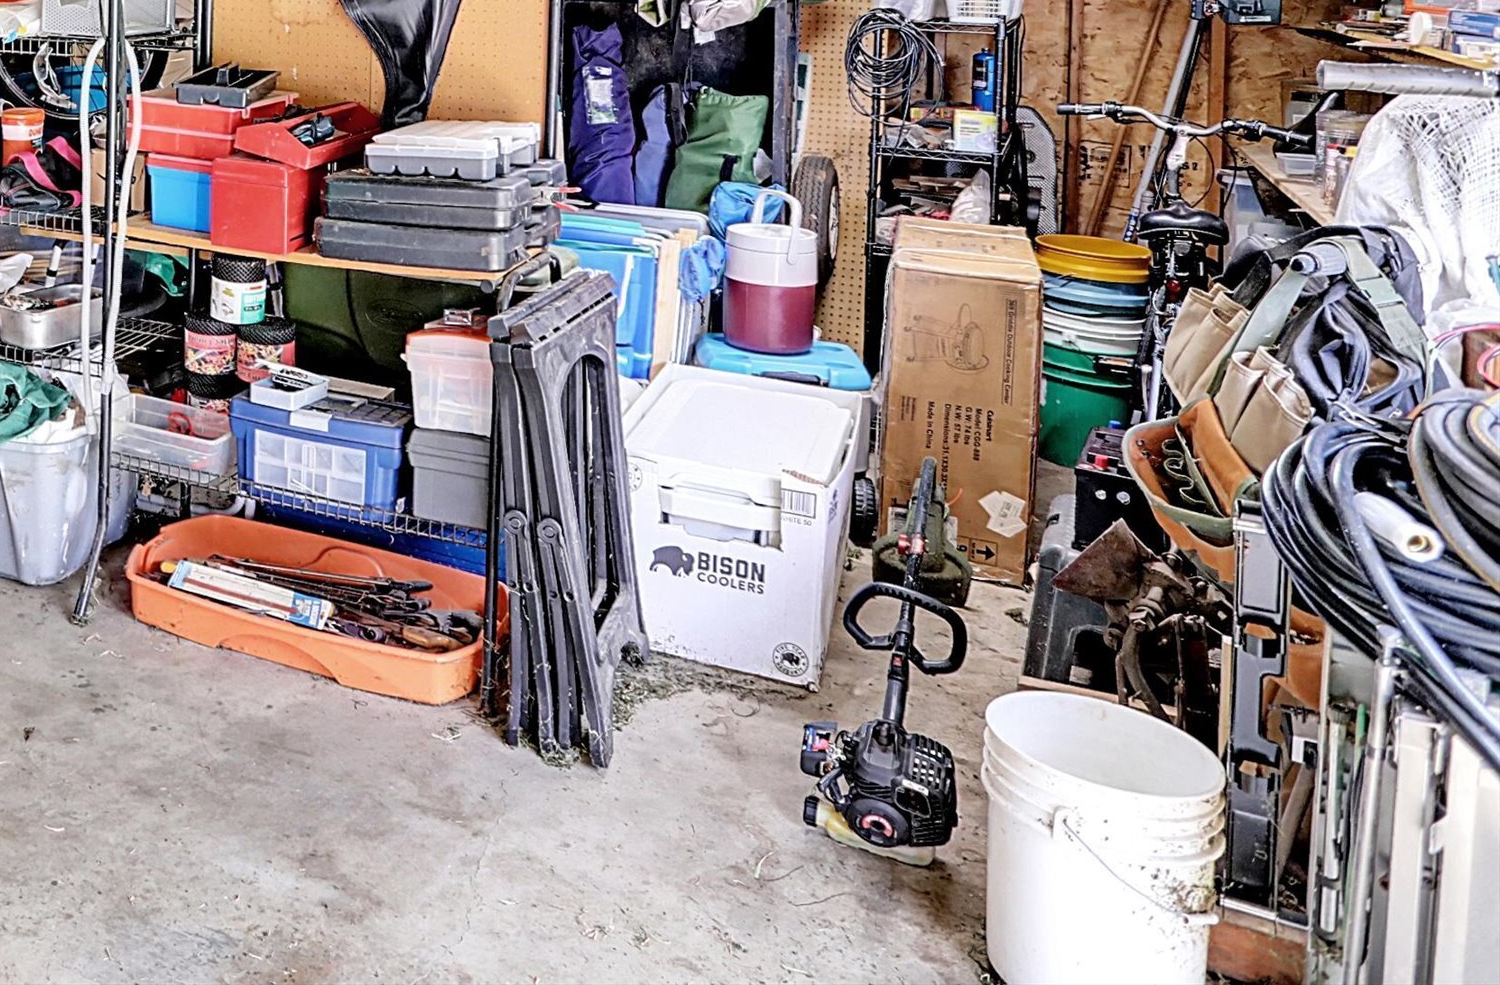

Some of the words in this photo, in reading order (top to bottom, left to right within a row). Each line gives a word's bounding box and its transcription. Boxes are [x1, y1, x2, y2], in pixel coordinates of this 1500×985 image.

[1006, 333, 1014, 359] Outdoor
[1003, 359, 1013, 383] Cooking
[1003, 384, 1012, 404] Center
[927, 401, 936, 420] Made
[974, 408, 983, 429] Model
[925, 428, 935, 450] China
[697, 551, 766, 583] BISON
[697, 572, 765, 595] COOLERS
